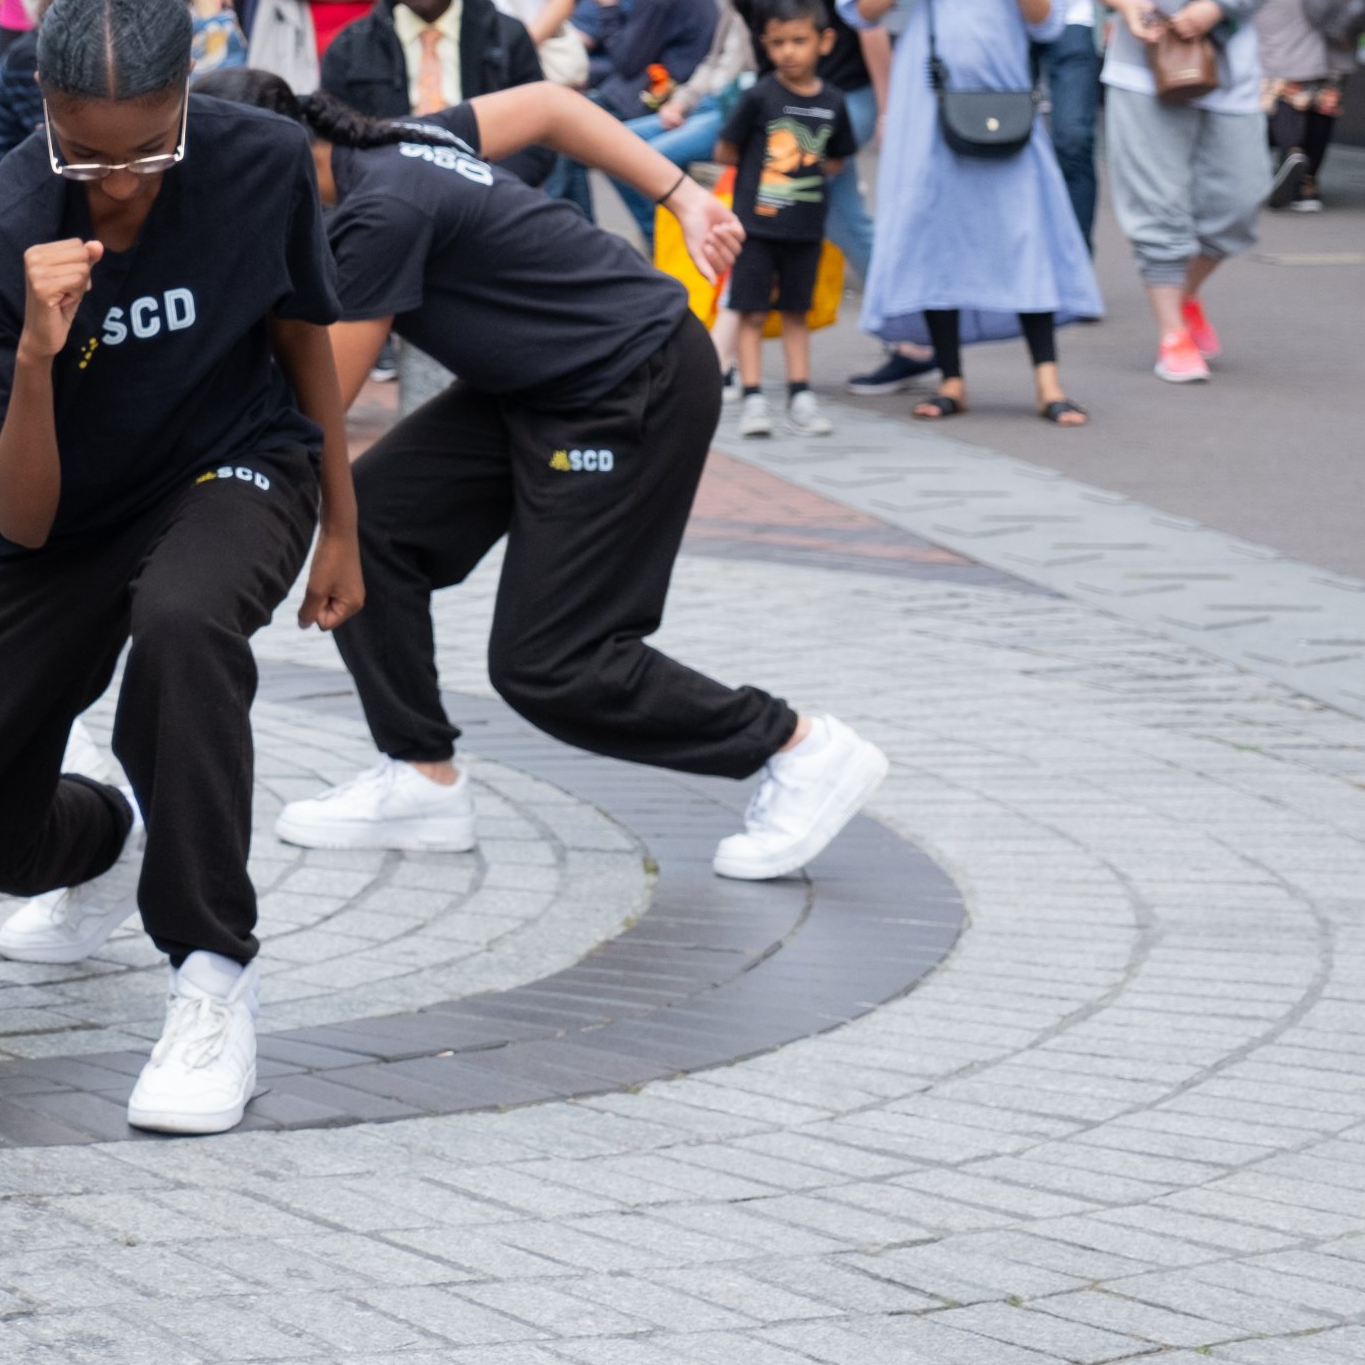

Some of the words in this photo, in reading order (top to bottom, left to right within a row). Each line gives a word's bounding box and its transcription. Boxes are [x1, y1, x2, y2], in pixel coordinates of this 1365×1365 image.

[101, 287, 196, 345] SCD
[568, 449, 614, 472] SCD
[216, 466, 270, 491] SCD
